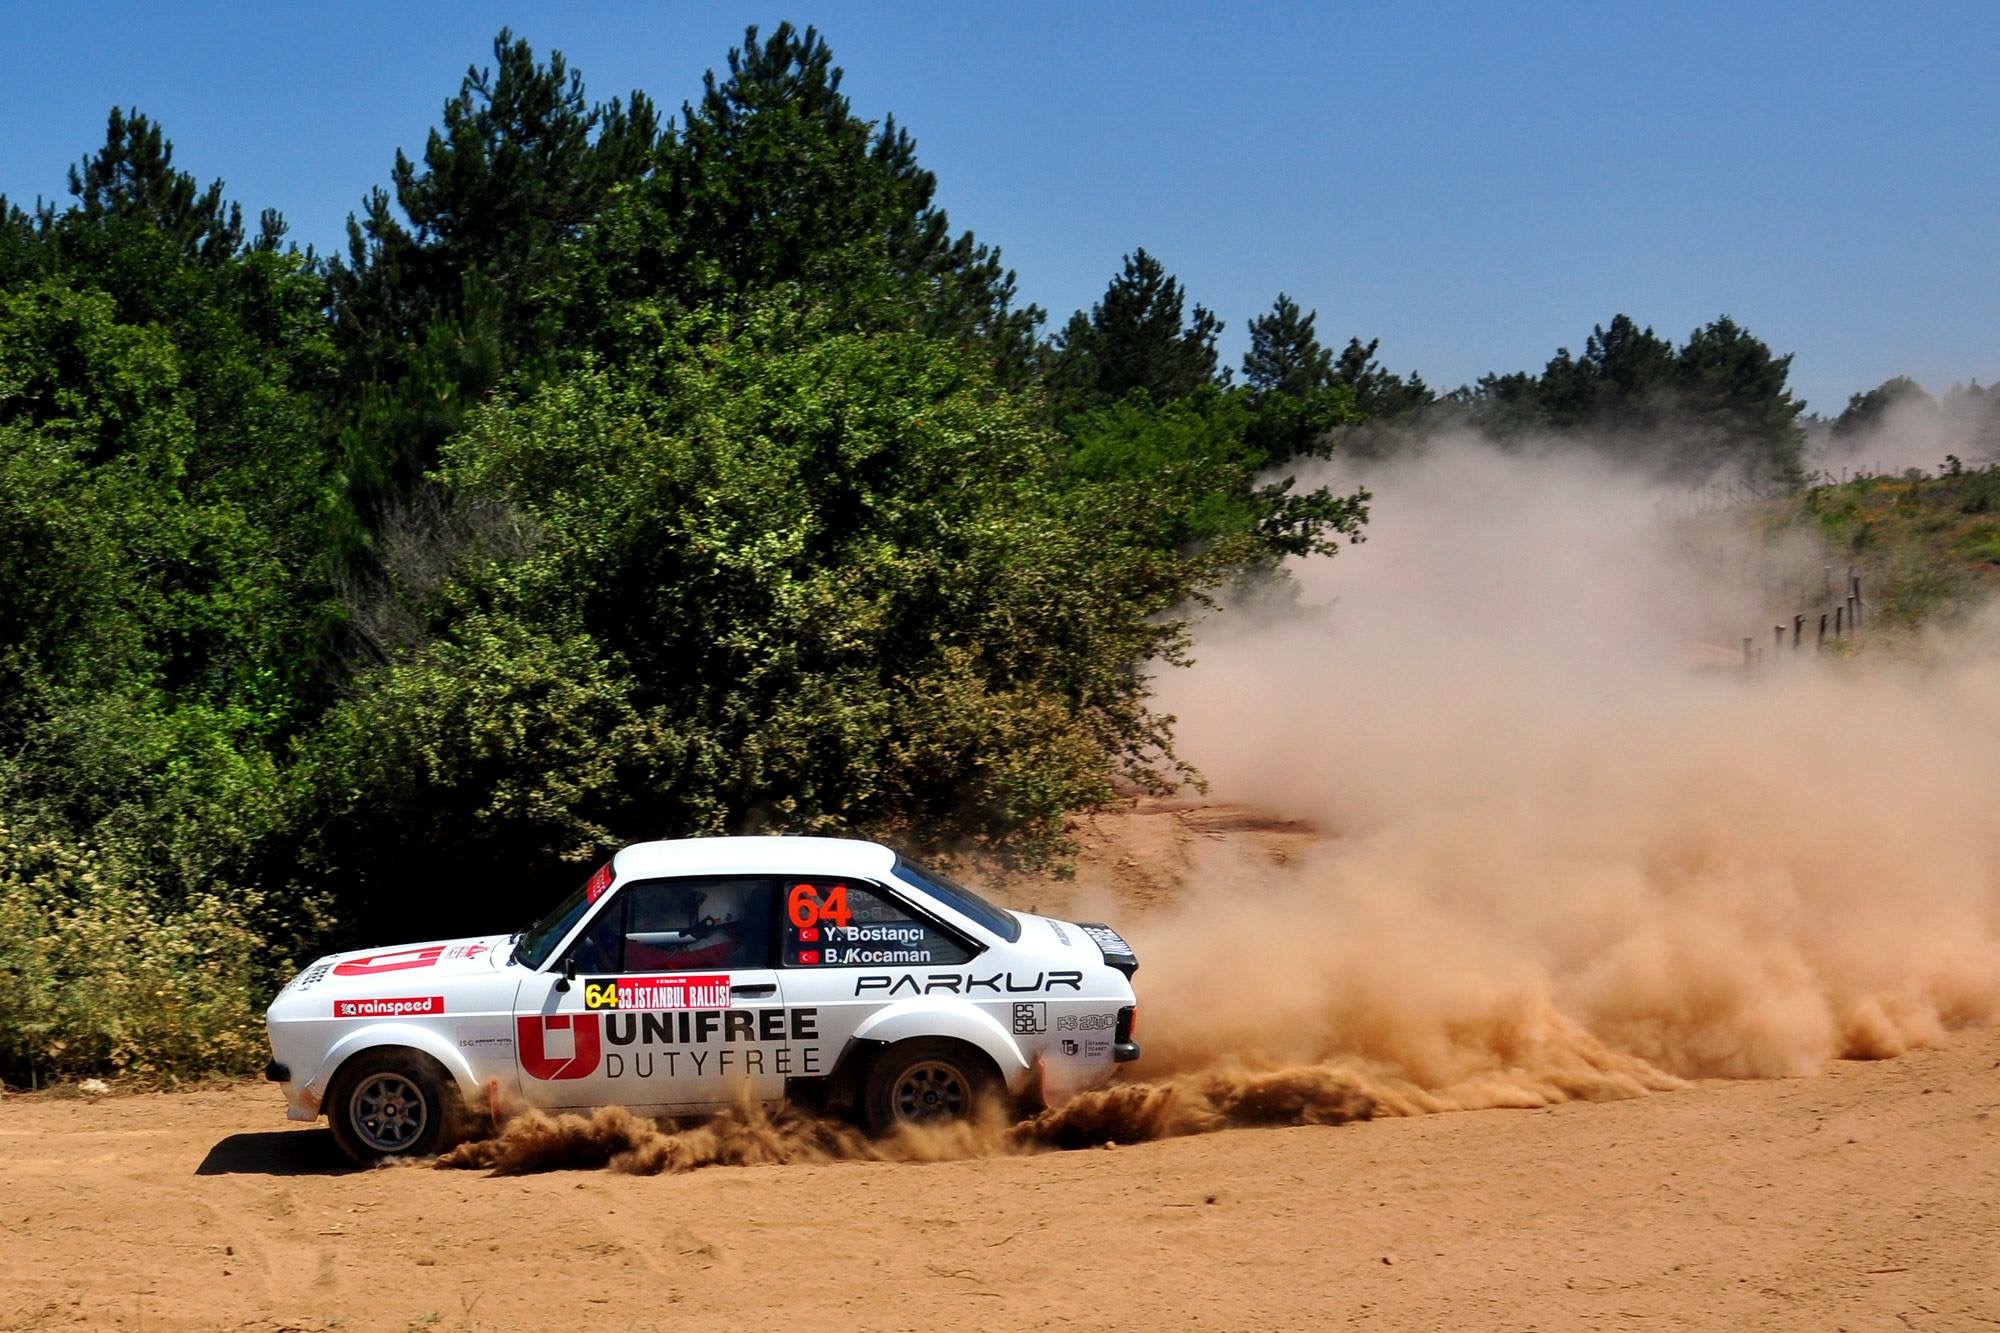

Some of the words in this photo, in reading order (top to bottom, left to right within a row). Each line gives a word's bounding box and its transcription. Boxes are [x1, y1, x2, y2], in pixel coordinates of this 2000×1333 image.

[788, 884, 852, 927] 64
[824, 926, 841, 941] Y.
[825, 948, 842, 963] B.
[848, 948, 931, 963] Kocaman
[585, 983, 618, 1008] 64
[855, 971, 1083, 996] PARKUR
[358, 998, 432, 1016] rainspeed
[605, 1008, 819, 1046] UNIFREE
[606, 1047, 820, 1078] DUTYFREE
